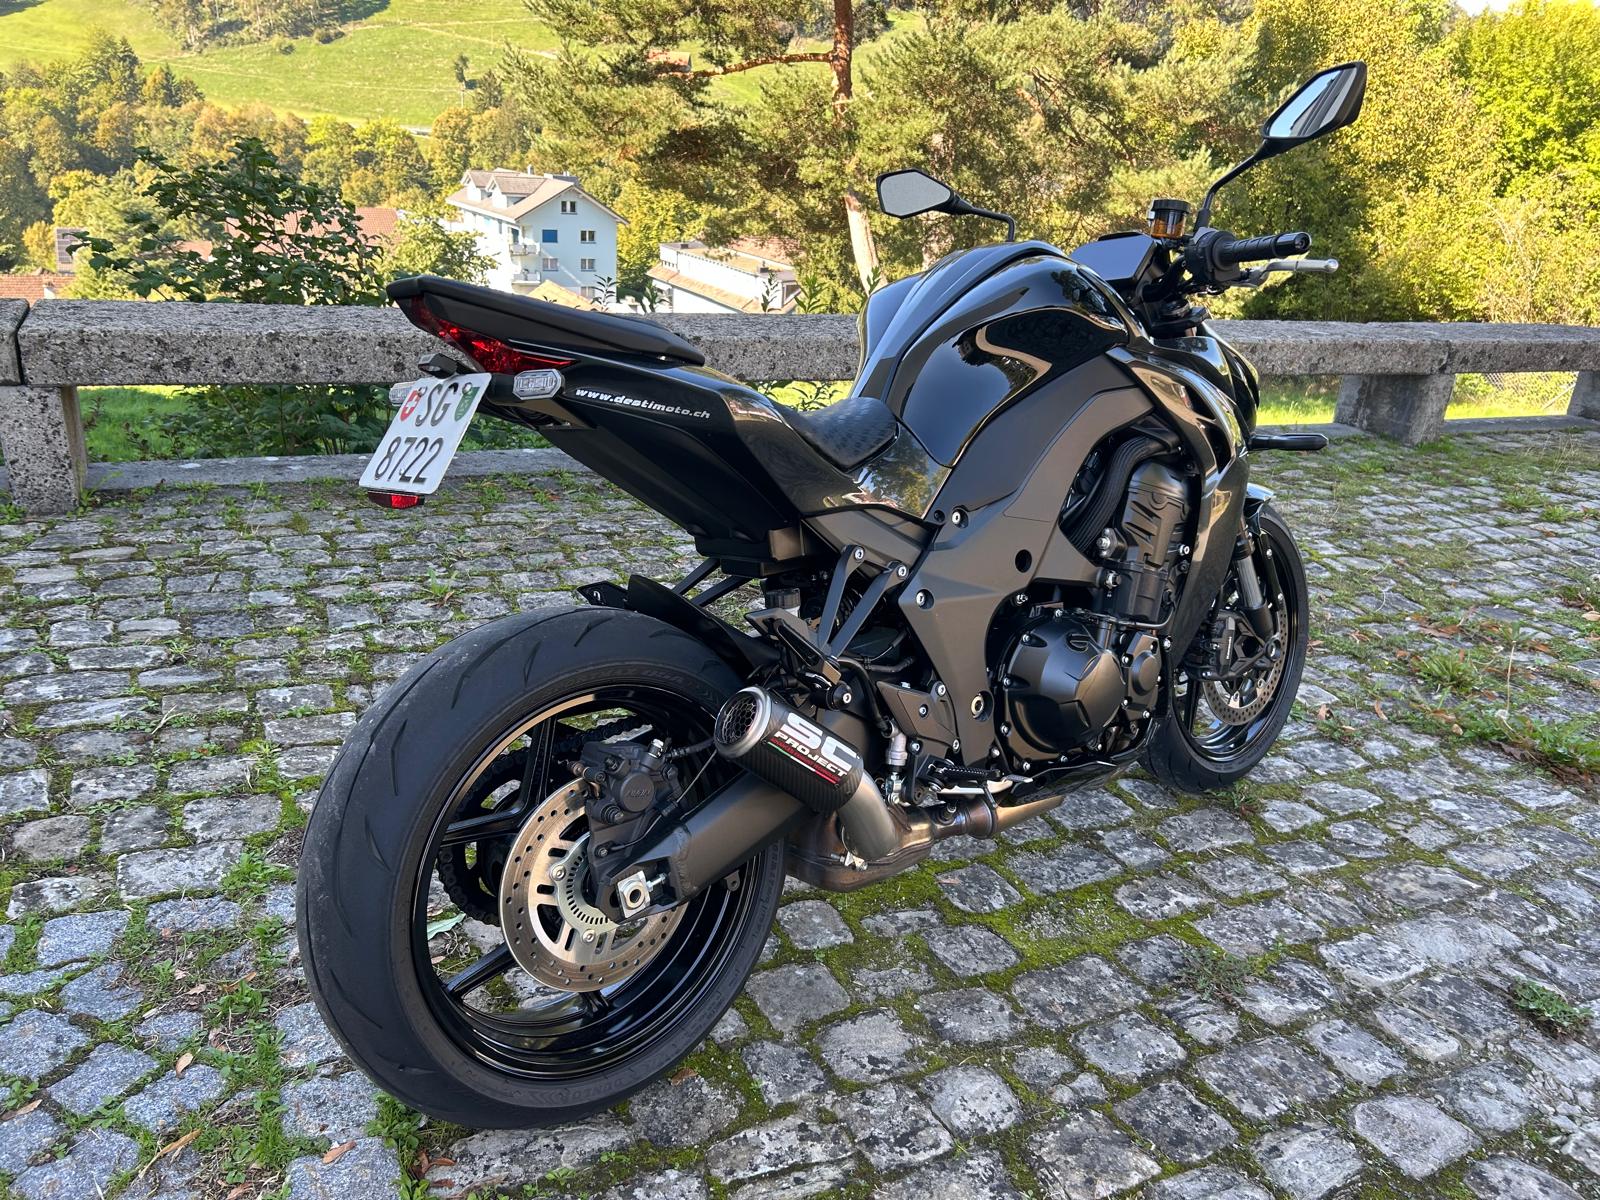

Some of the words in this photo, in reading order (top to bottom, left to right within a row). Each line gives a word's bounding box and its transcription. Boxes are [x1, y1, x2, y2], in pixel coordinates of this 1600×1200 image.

[415, 383, 459, 427] SG
[575, 389, 711, 419] www.destimoto.ch
[374, 436, 444, 484] 8722
[774, 731, 848, 777] PROJECT
[780, 712, 858, 772] SC
